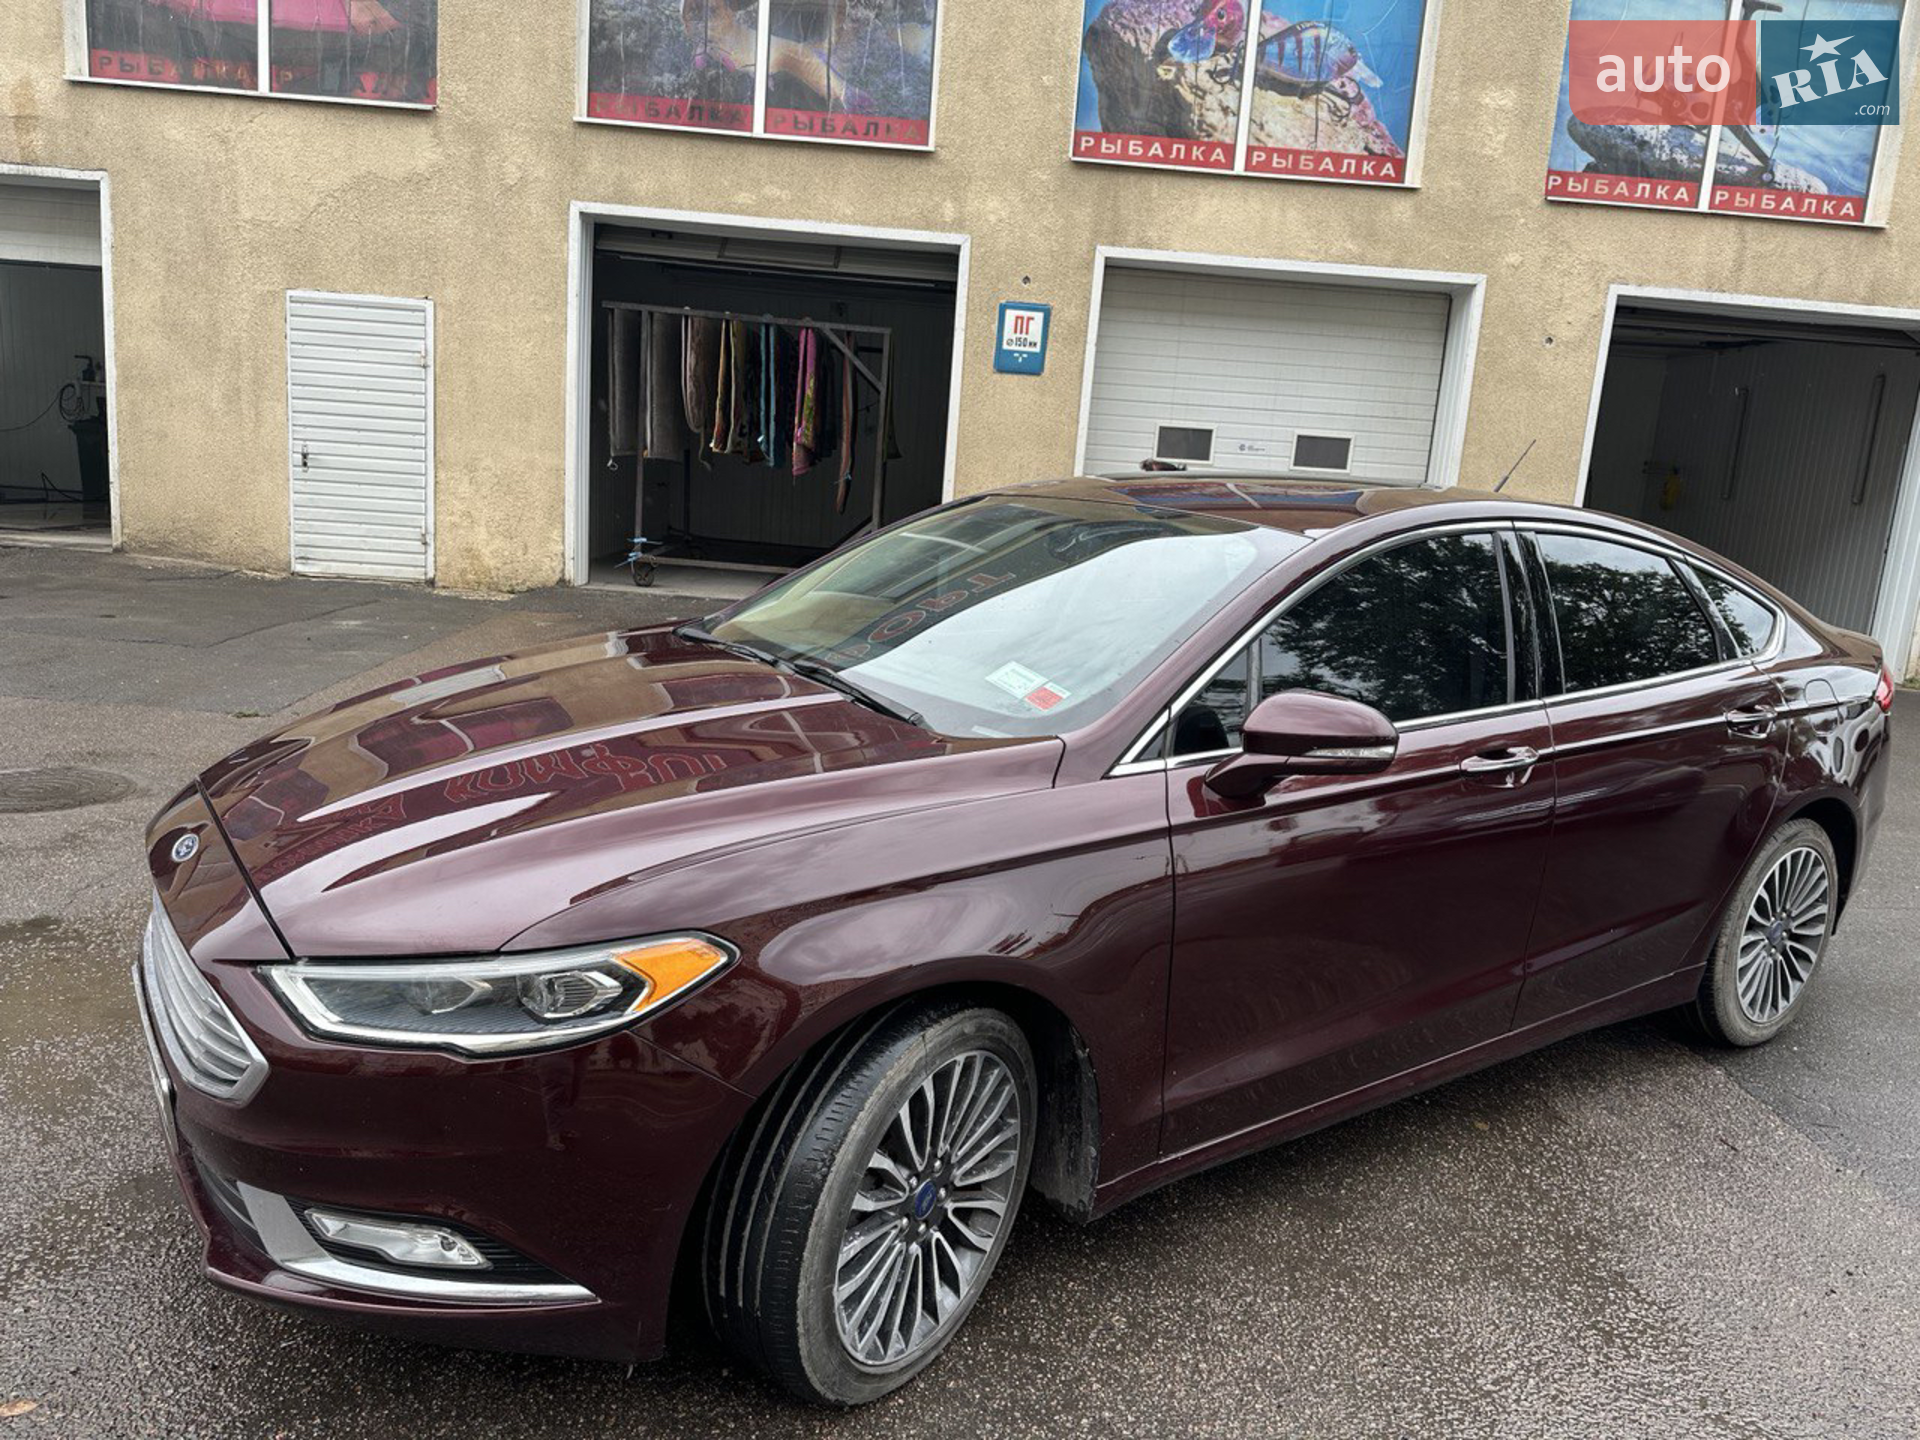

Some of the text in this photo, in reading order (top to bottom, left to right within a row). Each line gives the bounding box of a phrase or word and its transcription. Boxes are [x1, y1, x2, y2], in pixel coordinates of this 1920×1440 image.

[1080, 137, 1226, 164] РЫБАЛКА
[1251, 150, 1396, 177] РЫБАЛКА
[1547, 175, 1690, 202] РЫБАЛКА
[1714, 190, 1856, 217] РЫБАЛКА
[1013, 315, 1035, 335] ПГ
